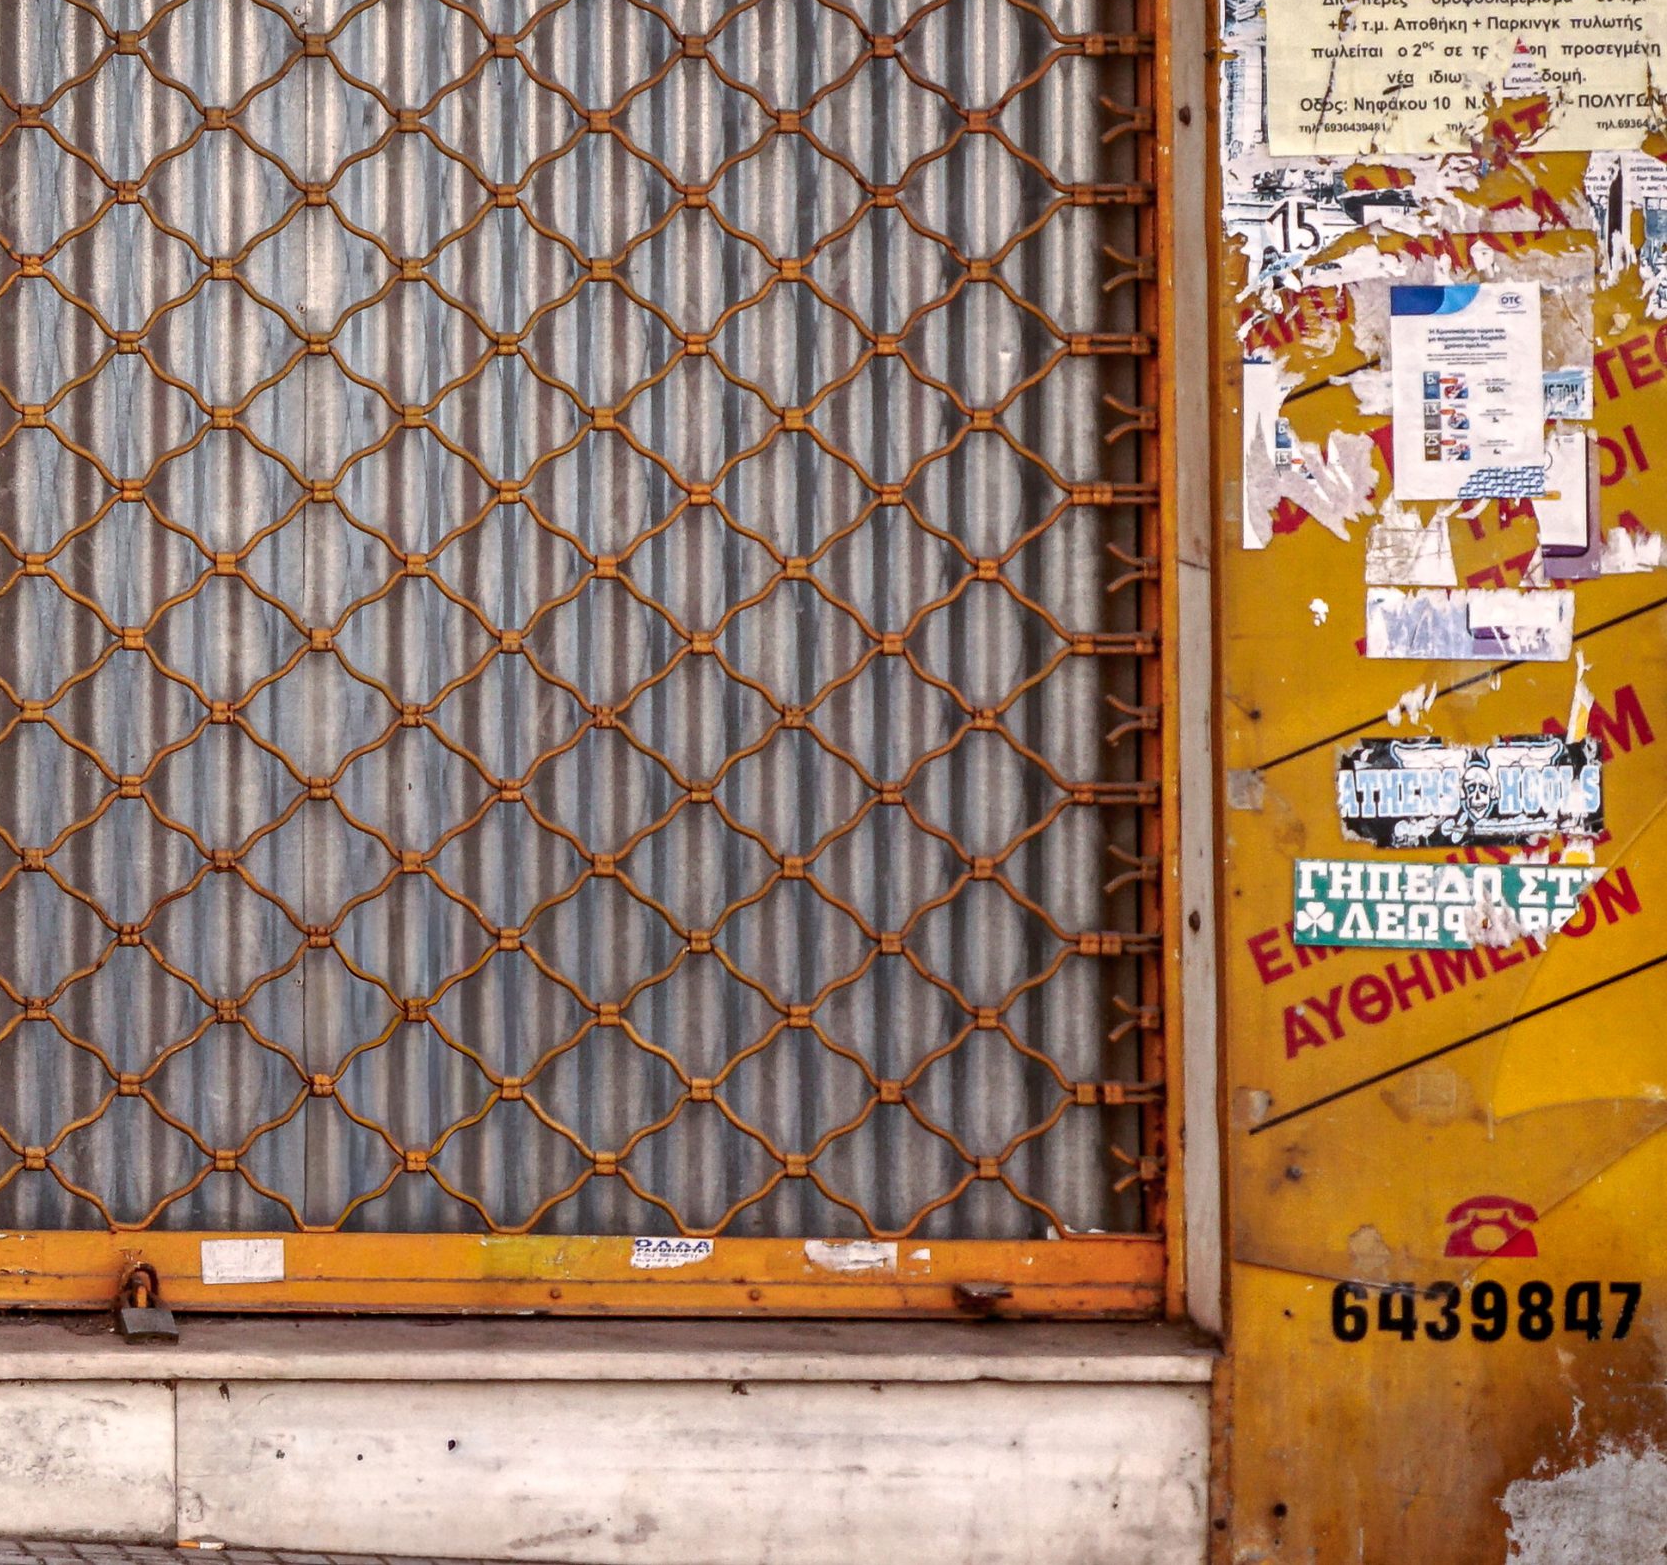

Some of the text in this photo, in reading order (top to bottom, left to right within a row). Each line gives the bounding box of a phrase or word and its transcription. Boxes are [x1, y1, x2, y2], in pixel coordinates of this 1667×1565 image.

[1394, 17, 1468, 33] Αποθήκη
[1487, 16, 1560, 32] Παρκινγκ
[1570, 14, 1643, 32] πυλωτής
[1310, 44, 1383, 58] πωλείται
[1444, 47, 1463, 57] σε
[1387, 70, 1414, 84] νέα
[1353, 95, 1427, 115] Νηφάκου
[1433, 96, 1451, 109] 10
[1518, 866, 1594, 905] ΣΤ
[1331, 1280, 1643, 1343] 6439847
